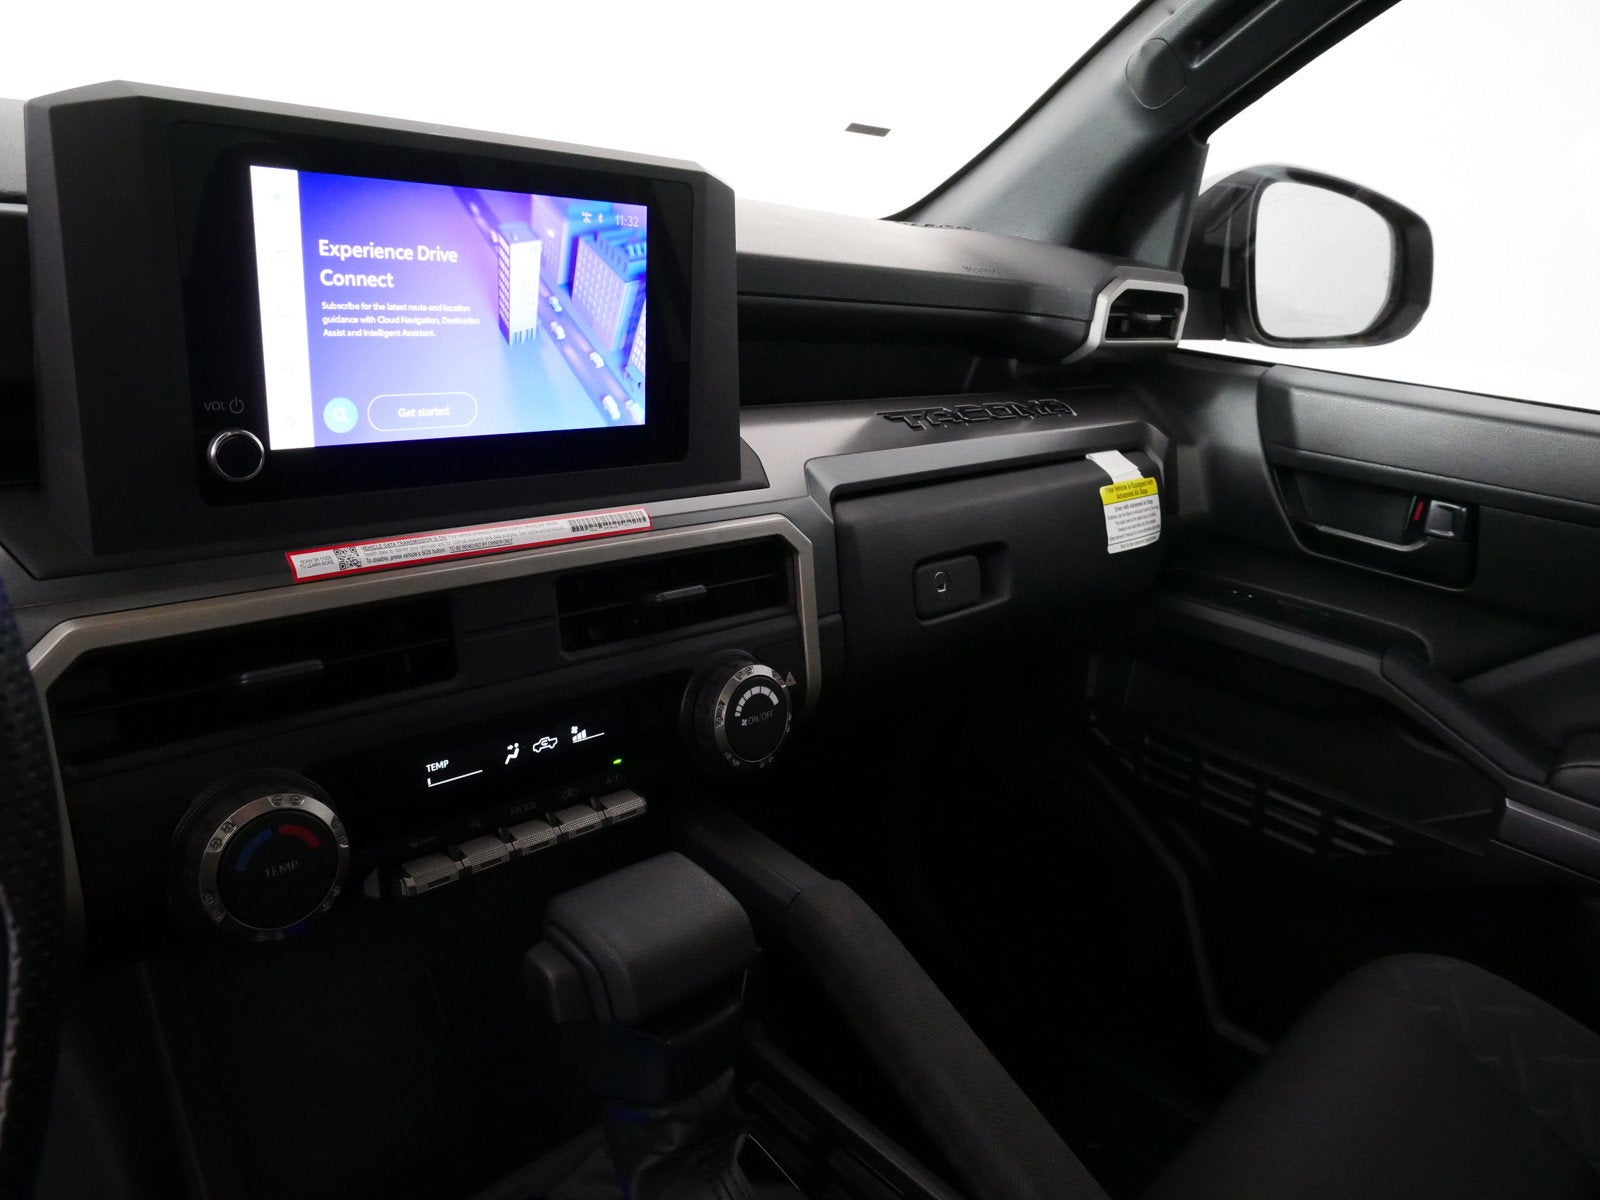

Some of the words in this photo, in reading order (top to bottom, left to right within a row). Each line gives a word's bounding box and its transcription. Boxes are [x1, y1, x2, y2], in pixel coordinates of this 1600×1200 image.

[614, 214, 639, 227] 11:32
[318, 239, 413, 261] Experience
[417, 244, 458, 263] Drive
[319, 269, 394, 288] Connect
[321, 301, 359, 310] Subscribe
[361, 301, 372, 311] for
[373, 302, 385, 311] the
[386, 302, 407, 311] latest
[408, 303, 427, 312] route
[428, 303, 442, 312] and
[443, 303, 470, 312] location
[322, 315, 358, 325] guidance
[360, 315, 376, 324] with
[377, 315, 400, 324] Cloud
[401, 316, 440, 326] Navigation,
[442, 316, 480, 325] Destination
[323, 329, 346, 337] Assist
[347, 329, 362, 337] and
[363, 328, 400, 338] Intelligent
[401, 329, 436, 337] Assistant.
[203, 401, 226, 411] VOL
[398, 406, 418, 418] Get
[419, 405, 450, 417] started
[875, 399, 1078, 431] TACOMA
[748, 710, 775, 725] ON/OFF
[426, 759, 450, 773] TEMP
[510, 800, 538, 816] MODE
[263, 859, 300, 880] TEMP
